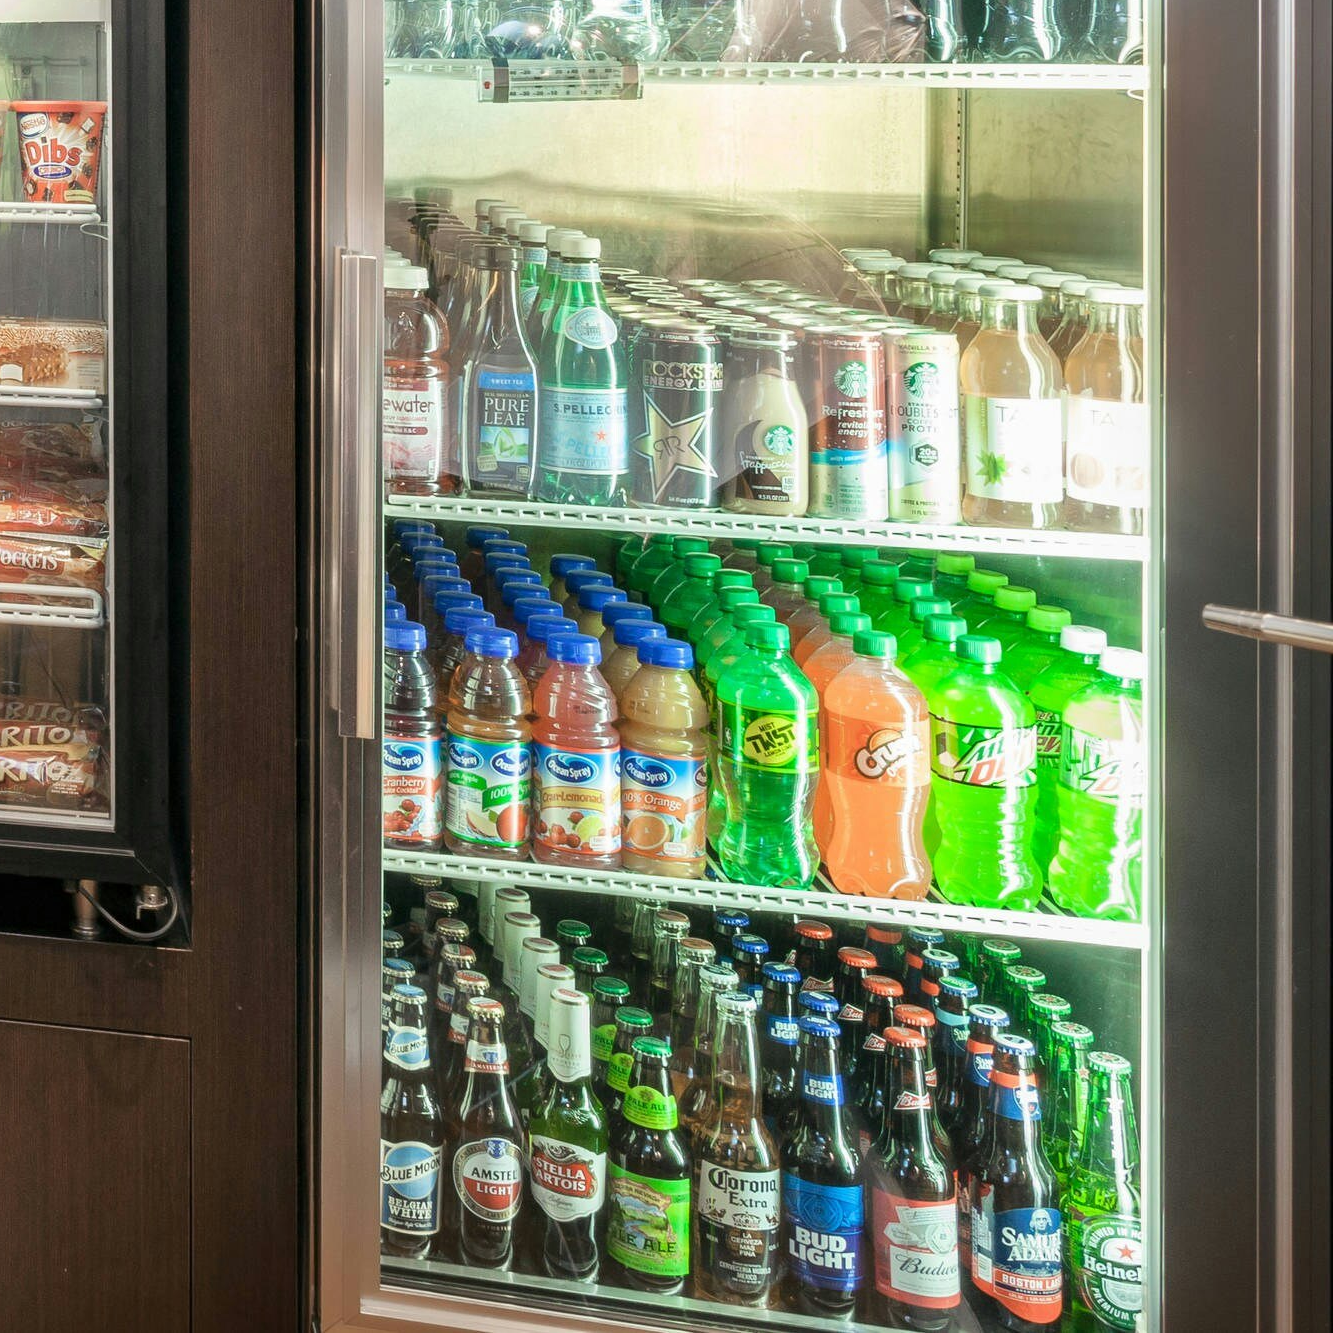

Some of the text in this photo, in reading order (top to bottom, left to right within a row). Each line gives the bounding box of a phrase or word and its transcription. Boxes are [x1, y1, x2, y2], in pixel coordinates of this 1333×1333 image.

[20, 116, 47, 130] Nestlé
[25, 137, 83, 166] Dibs
[644, 375, 694, 388] ENERGY
[484, 398, 530, 413] PURE
[838, 429, 871, 438] energy
[758, 722, 776, 732] MIST
[401, 753, 422, 767] Spray
[547, 760, 592, 780] Ocean Spray
[626, 761, 668, 784] Ocean Spray
[396, 786, 419, 794] Cocktail
[644, 793, 683, 811] Orange
[773, 1021, 798, 1032] BUD
[390, 1040, 410, 1054] BLUE
[805, 1078, 839, 1100] BUD LIGHT
[628, 1094, 668, 1111] PALE ALE
[380, 1156, 440, 1184] BLUE MOON
[471, 1167, 518, 1181] AMSTEL
[536, 1155, 587, 1182] STELLA
[536, 1168, 587, 1193] ARTOIS
[708, 1166, 778, 1194] Corona
[476, 1182, 513, 1197] LIGHT
[387, 1194, 433, 1210] BELGIAN
[728, 1190, 768, 1209] Extra
[388, 1205, 433, 1220] WHITE
[730, 1236, 763, 1246] CERVEZA
[742, 1231, 752, 1239] LA
[794, 1224, 848, 1253] BUD
[1001, 1226, 1062, 1249] SAMUEL
[1089, 1225, 1128, 1249] BREWED IN
[643, 1236, 677, 1254] ALE
[739, 1243, 755, 1252] MAS
[788, 1237, 856, 1270] LIGHT
[1006, 1244, 1061, 1263] ADAMS
[739, 1250, 756, 1258] FINA
[736, 1272, 758, 1281] MEXICO
[1001, 1272, 1044, 1291] BOSTON
[1090, 1286, 1130, 1321] PREMIUM
